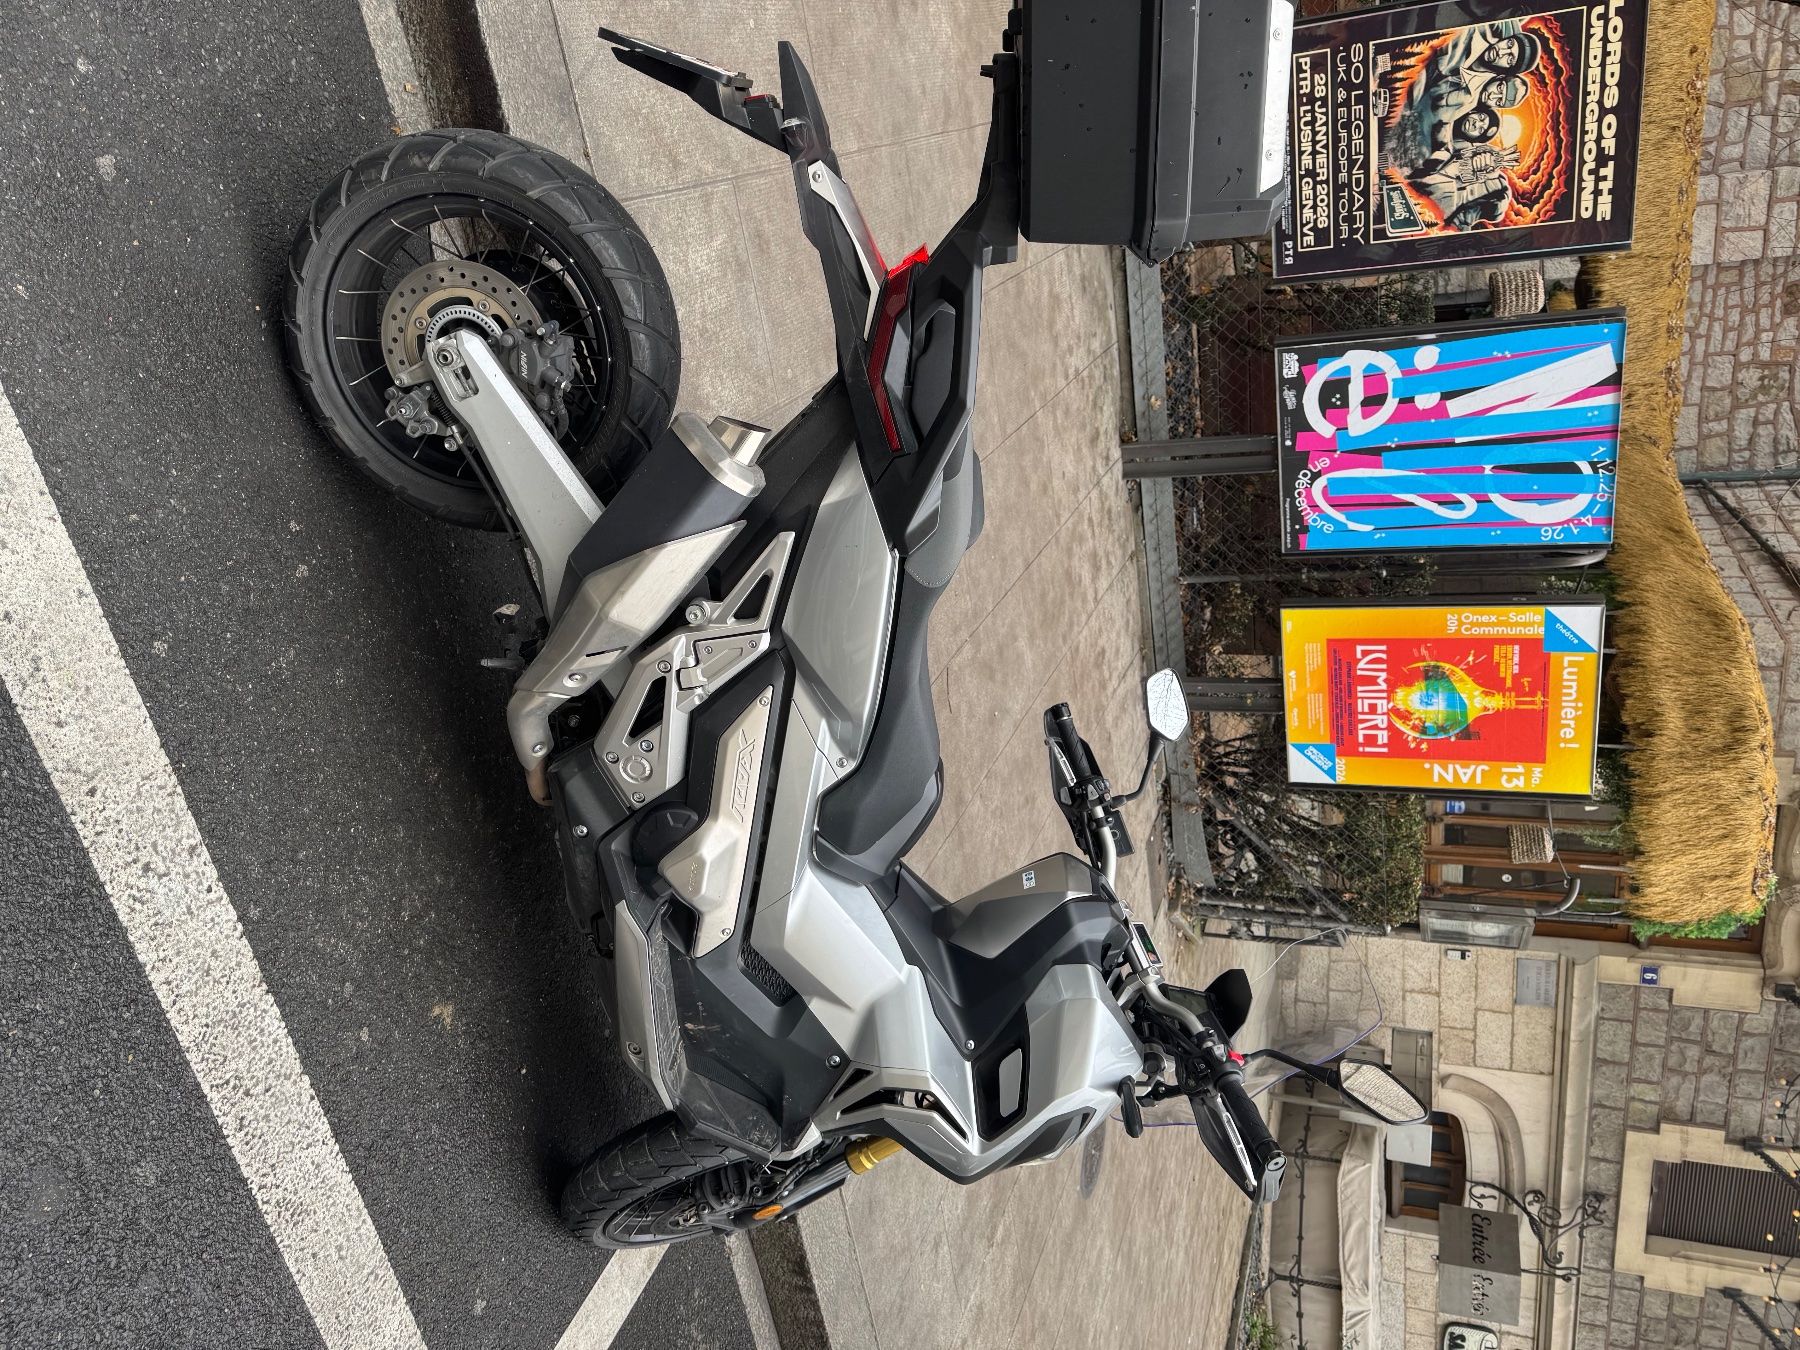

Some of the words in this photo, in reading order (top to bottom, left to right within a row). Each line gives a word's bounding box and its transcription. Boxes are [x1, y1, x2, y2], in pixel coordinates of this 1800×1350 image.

[1299, 57, 1311, 93] PTR
[1351, 43, 1364, 83] SO
[1603, 0, 1625, 108] LORDS
[1314, 73, 1326, 98] 28
[1338, 87, 1348, 103] &
[1580, 5, 1605, 219] UNDERGROUND
[1315, 101, 1328, 181] JANVIER
[1338, 108, 1348, 184] EUROPE
[1601, 114, 1617, 156] OF
[1351, 91, 1365, 245] LEGENDARY
[1301, 178, 1316, 247] GENÈVE
[1317, 184, 1329, 228] 2026
[1596, 161, 1615, 222] THE
[1308, 457, 1331, 473] en
[1294, 469, 1334, 534] décembre
[1447, 614, 1458, 634] 20h
[1461, 613, 1497, 623] Onex
[1509, 612, 1541, 623] Salle
[1461, 624, 1544, 635] Communale
[1356, 645, 1393, 745] LUMIÈRE
[1560, 656, 1585, 739] Lumière
[1423, 763, 1490, 784] JAN.
[1501, 765, 1524, 788] 13
[1531, 768, 1543, 788] Ma.
[1471, 1213, 1492, 1265] Entrée
